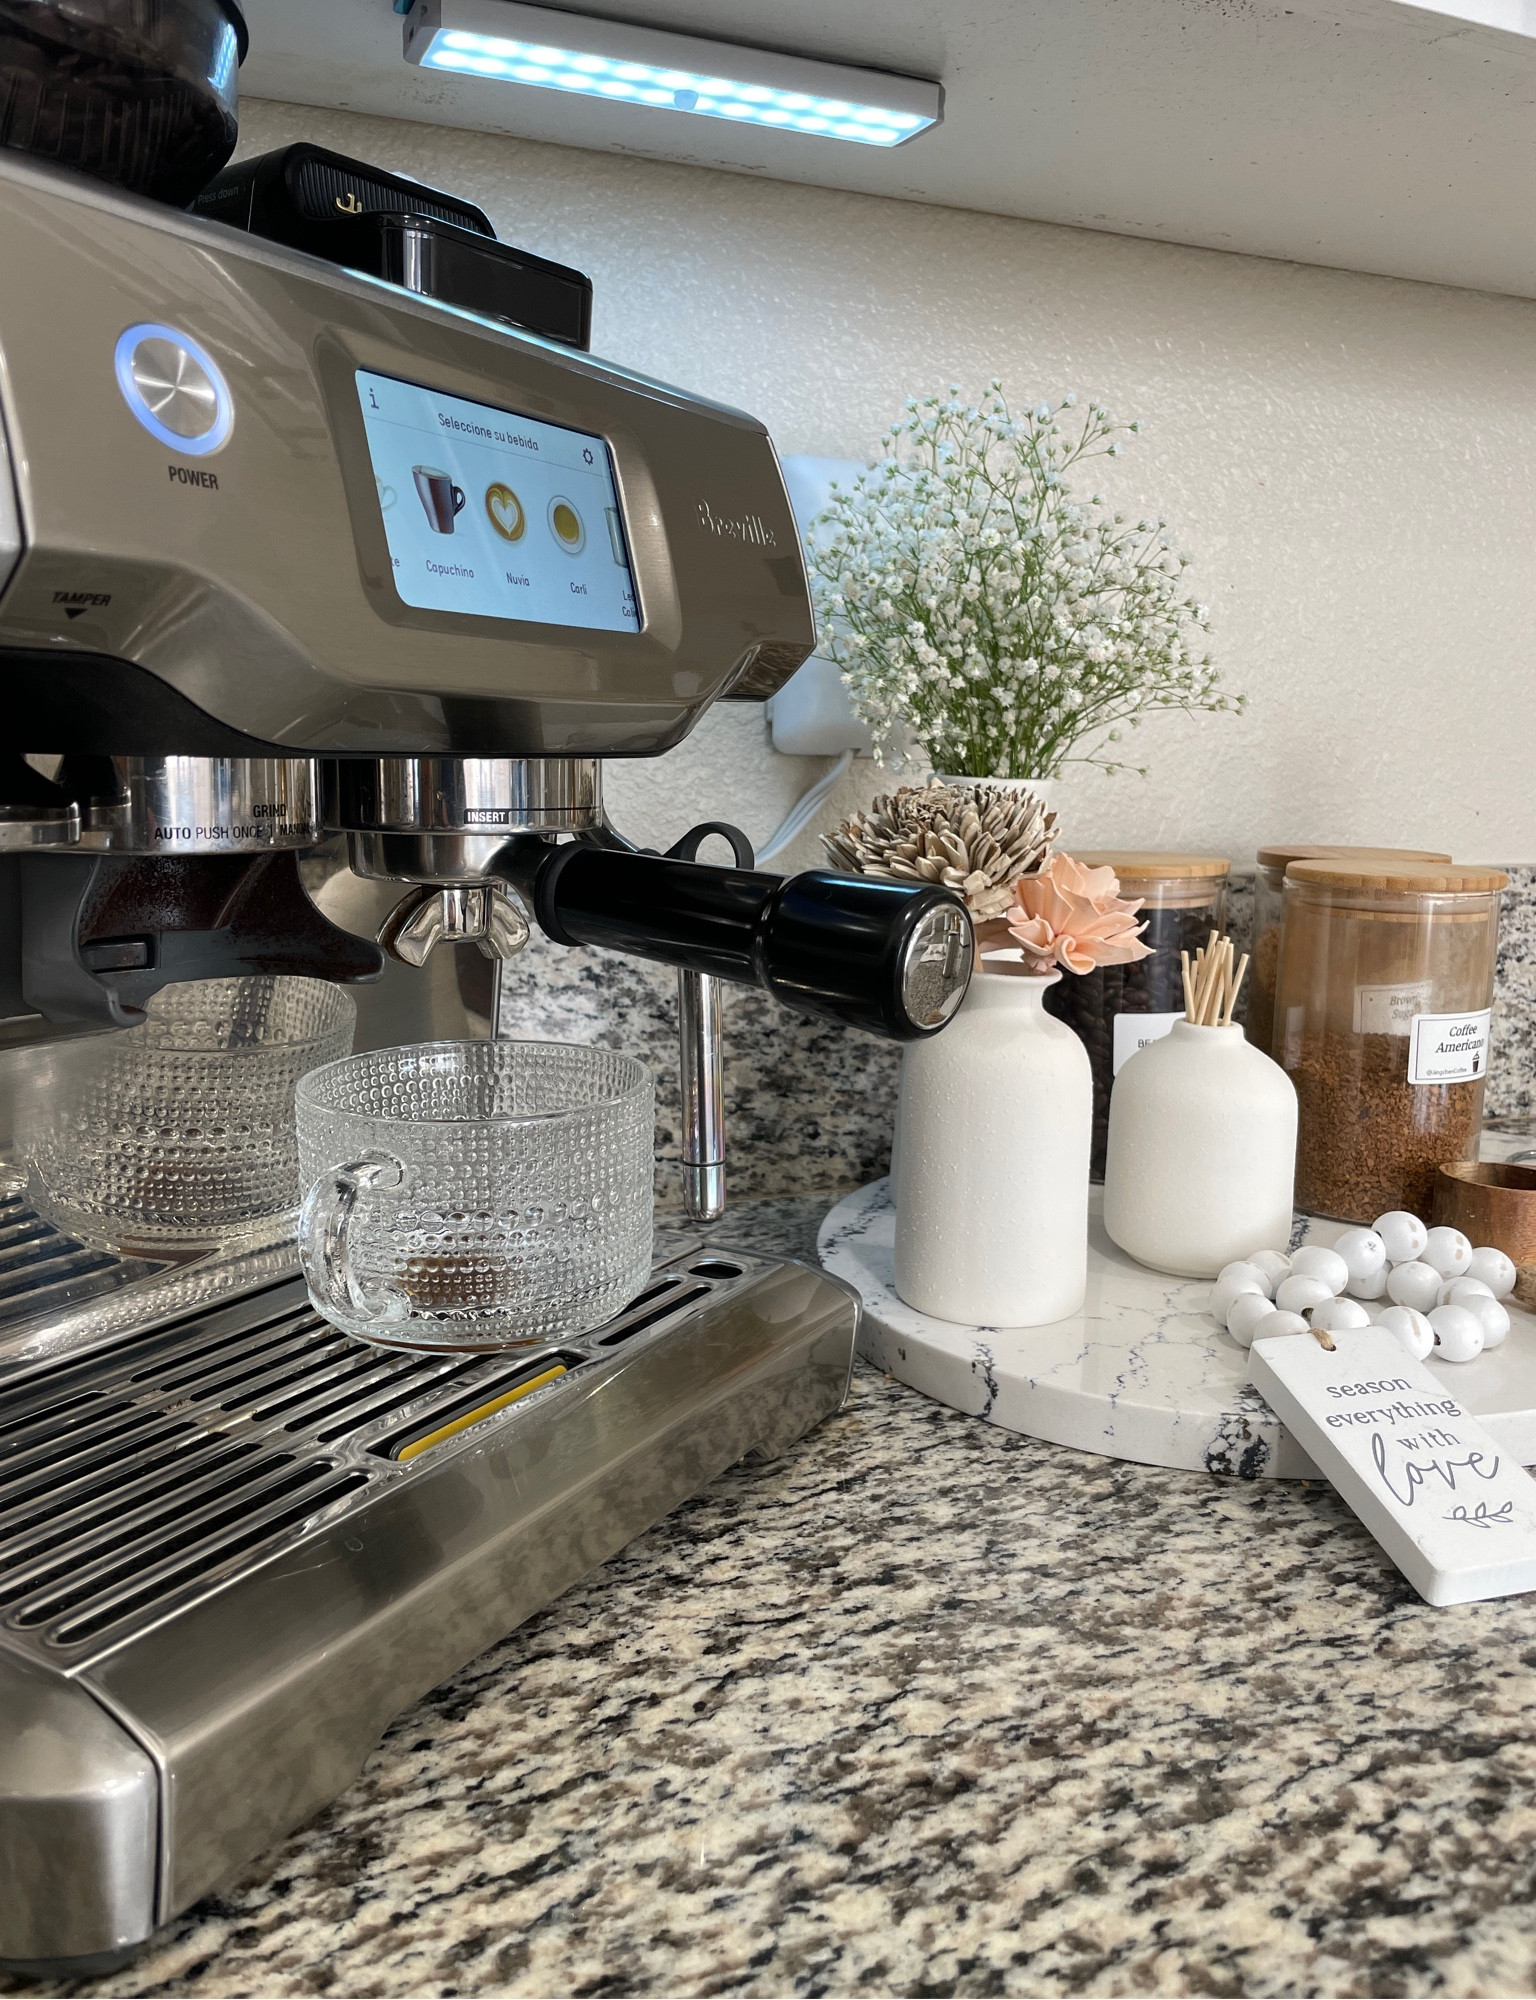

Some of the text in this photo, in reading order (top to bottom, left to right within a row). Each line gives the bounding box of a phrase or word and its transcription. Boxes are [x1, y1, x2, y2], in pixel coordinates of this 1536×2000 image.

[217, 186, 240, 200] down
[437, 413, 540, 451] Seleccione su bebida
[168, 465, 219, 490] POWER
[695, 499, 777, 547] Breville
[425, 559, 475, 578] Capuchino
[506, 572, 531, 587] Nuvia
[570, 582, 588, 595] Carli
[52, 591, 111, 607] TAMPER
[253, 804, 287, 818] GRIND
[467, 811, 506, 823] INSERT
[154, 827, 192, 840] AUTO
[196, 826, 229, 839] PUSH
[232, 825, 262, 838] ONCE
[1449, 1024, 1478, 1037] Coffee
[1435, 1038, 1485, 1053] Americano
[1325, 1378, 1412, 1398] season
[1325, 1400, 1461, 1428] everything
[1396, 1428, 1460, 1451] with
[1371, 1432, 1500, 1507] love
